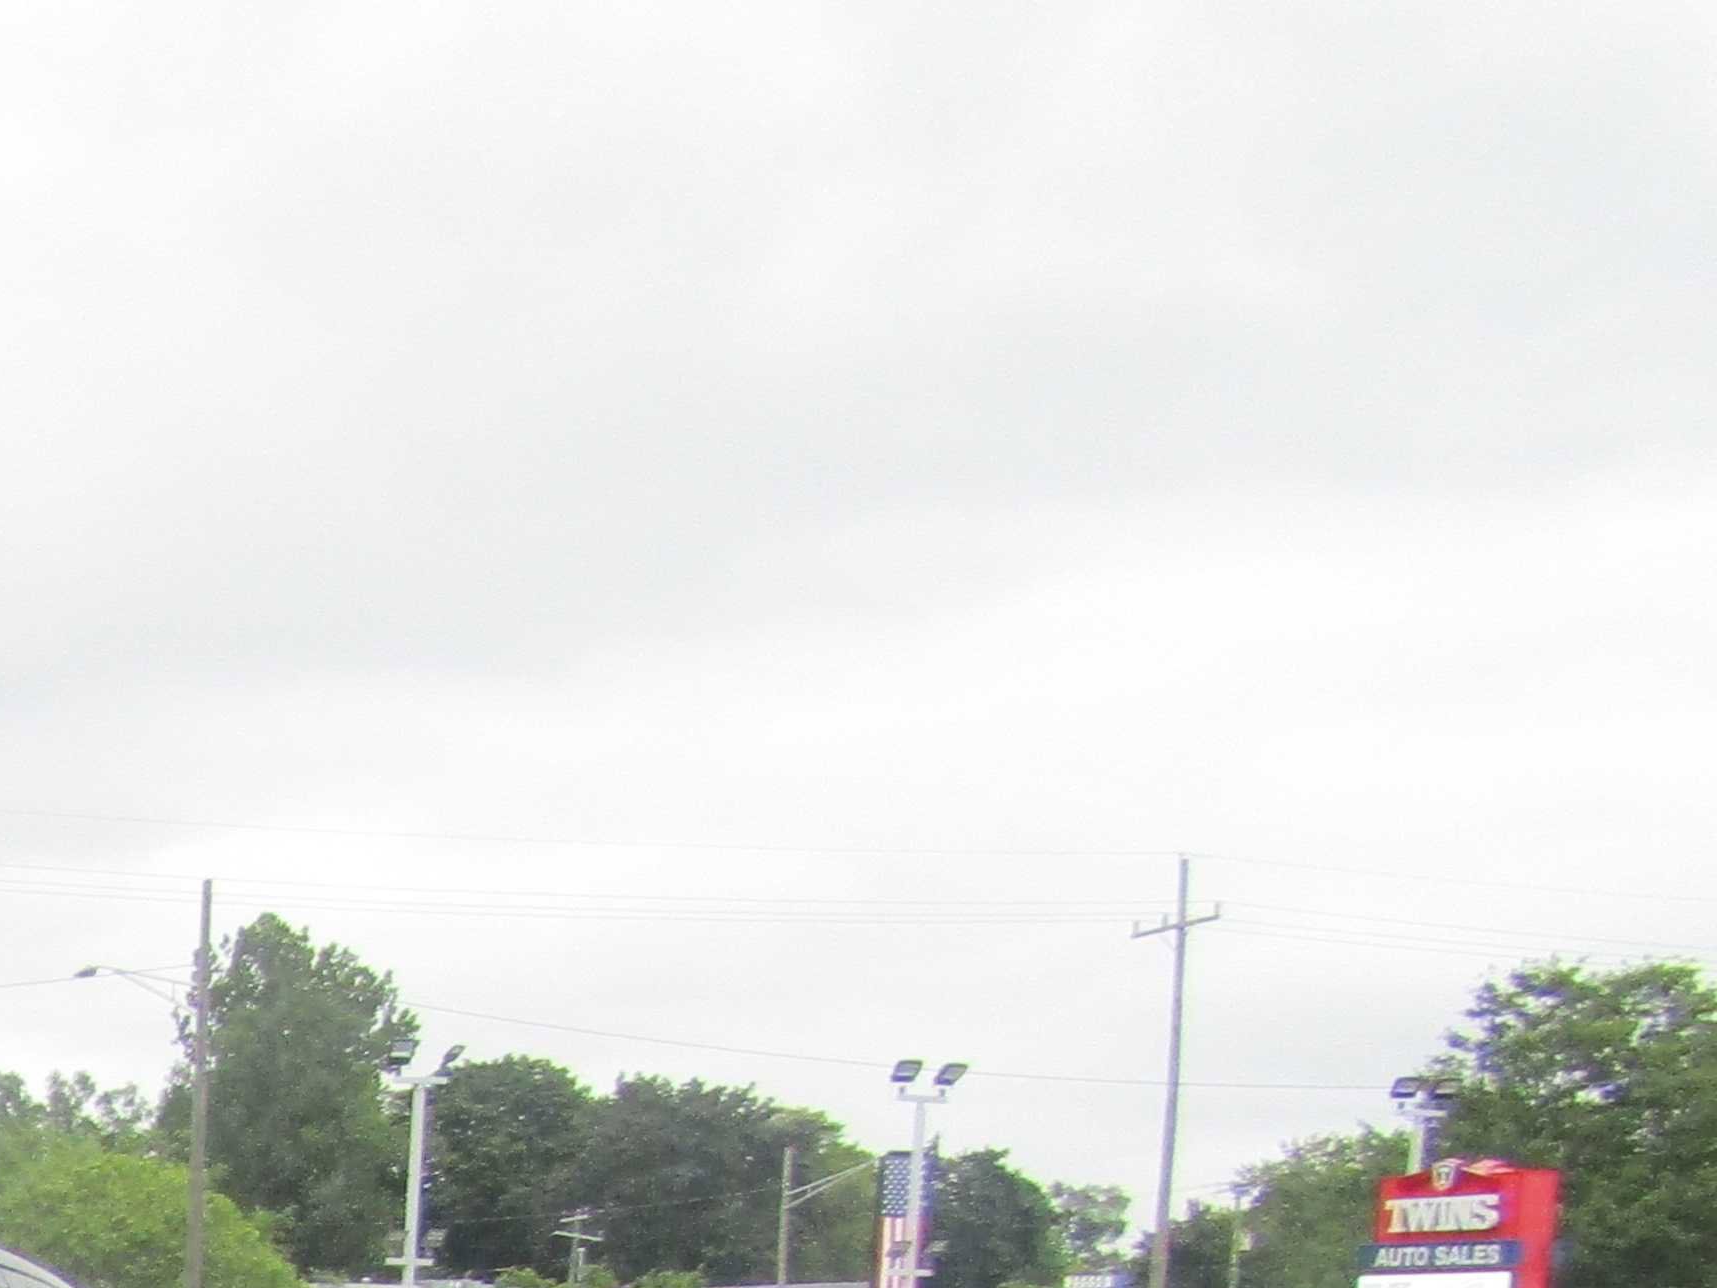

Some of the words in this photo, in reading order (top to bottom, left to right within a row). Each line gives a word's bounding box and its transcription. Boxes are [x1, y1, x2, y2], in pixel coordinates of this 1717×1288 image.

[1385, 1194, 1501, 1233] TWINS
[1373, 1247, 1430, 1267] AUTO
[1434, 1244, 1502, 1265] SALES
